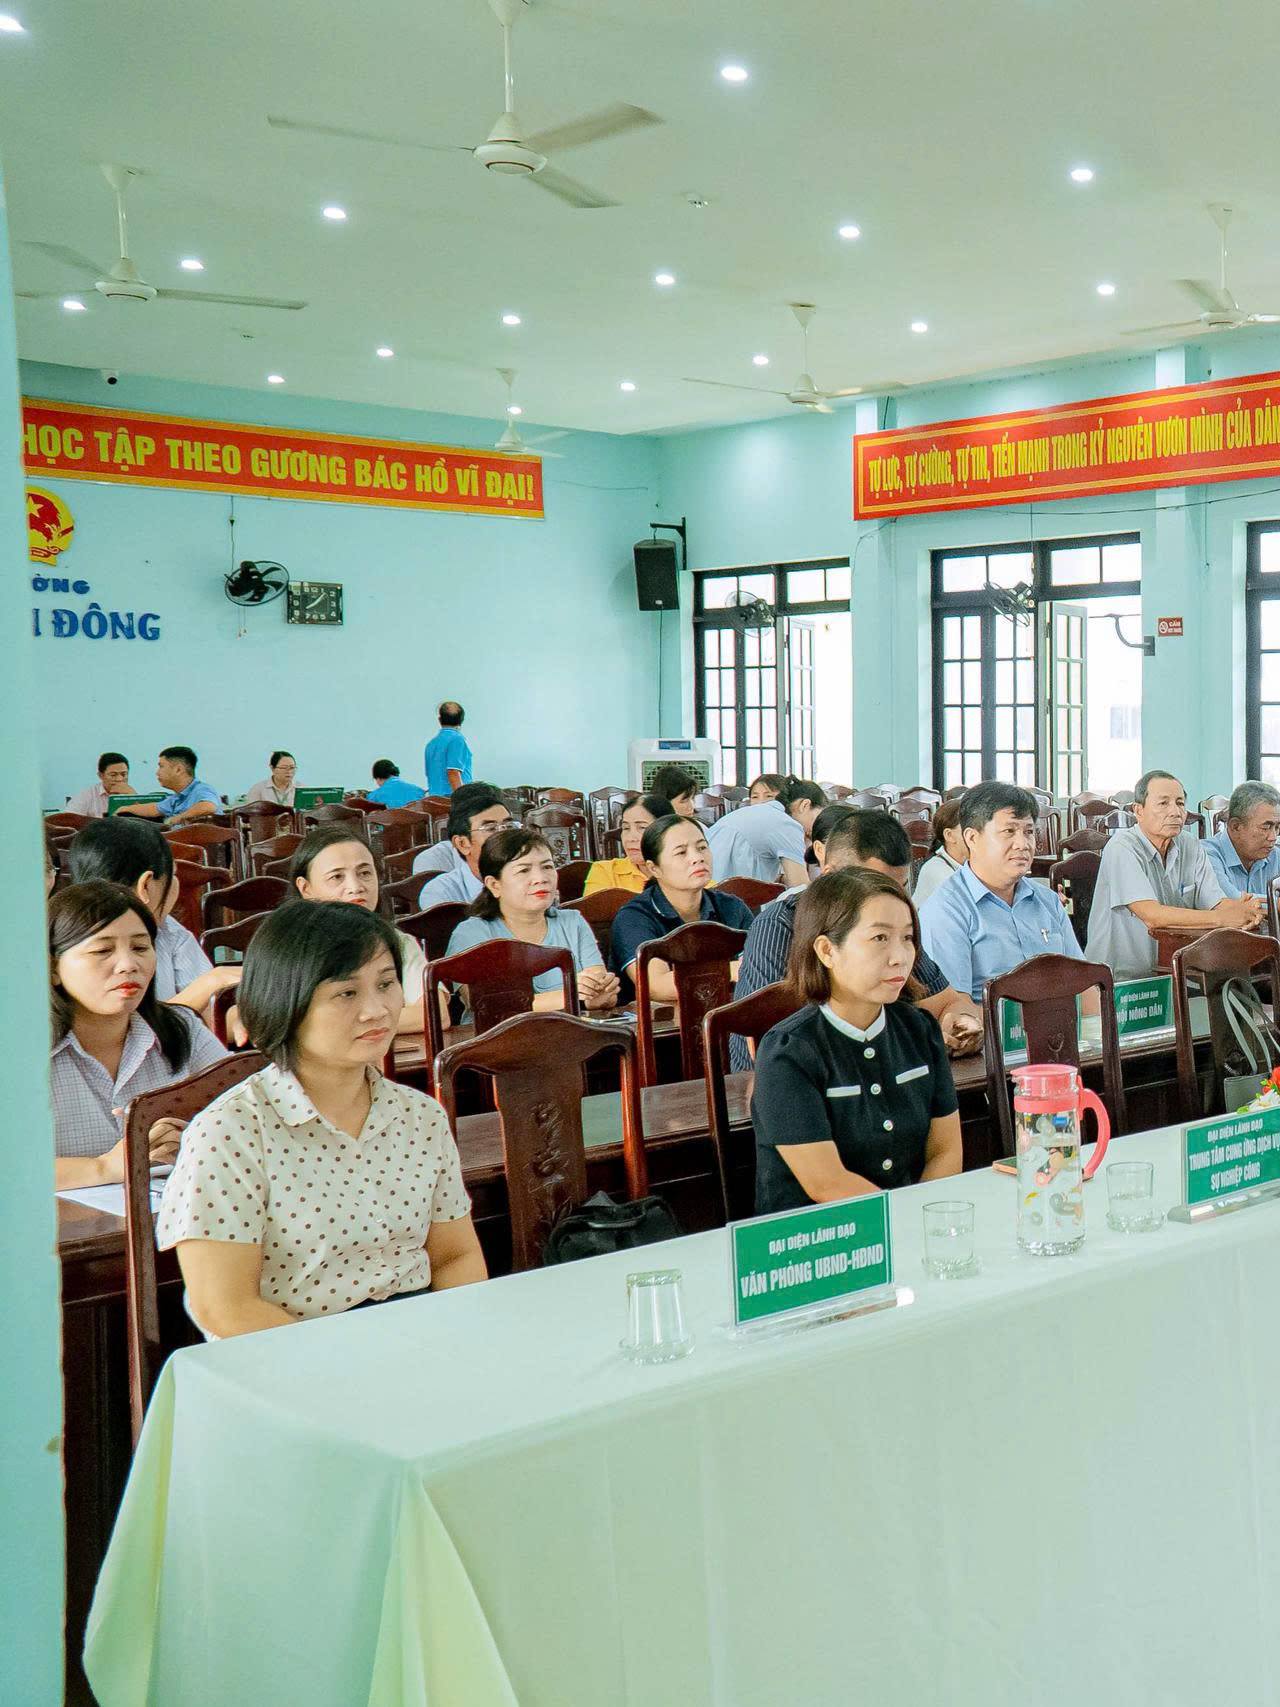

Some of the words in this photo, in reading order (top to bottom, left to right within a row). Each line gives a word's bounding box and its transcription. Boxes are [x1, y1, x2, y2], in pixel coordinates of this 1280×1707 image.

[23, 423, 84, 465] HỌC
[93, 427, 155, 471] TẬP
[165, 438, 241, 475] THEO
[251, 447, 346, 485] GƯƠNG
[354, 455, 407, 490] BÁC
[415, 457, 448, 494] HỒ
[455, 463, 479, 497] VĨ
[485, 470, 534, 505] ĐẠI!
[869, 456, 881, 499] TỰ
[882, 454, 903, 498] LỰC,
[905, 451, 917, 494] TỰ
[919, 444, 954, 487] CƯỜNG,
[956, 445, 970, 489] TỰ
[971, 446, 990, 483] TIN,
[992, 431, 1016, 478] TIẾN
[1018, 437, 1050, 481] MẠNH
[1052, 432, 1087, 471] TRONG
[1090, 418, 1104, 466] KỶ
[1107, 416, 1153, 464] NGUYÊN
[1155, 415, 1187, 458] VƯƠN
[1190, 407, 1223, 454] MÌNH
[1226, 397, 1252, 450] CỦA
[52, 602, 160, 640] ĐÔNG
[769, 1239, 785, 1255] ĐẠI
[787, 1232, 810, 1251] DIỆN
[811, 1227, 835, 1244] LÃNH
[837, 1222, 856, 1239] ĐẠO
[740, 1270, 767, 1298] VĂN
[770, 1260, 812, 1291] PHÒNG
